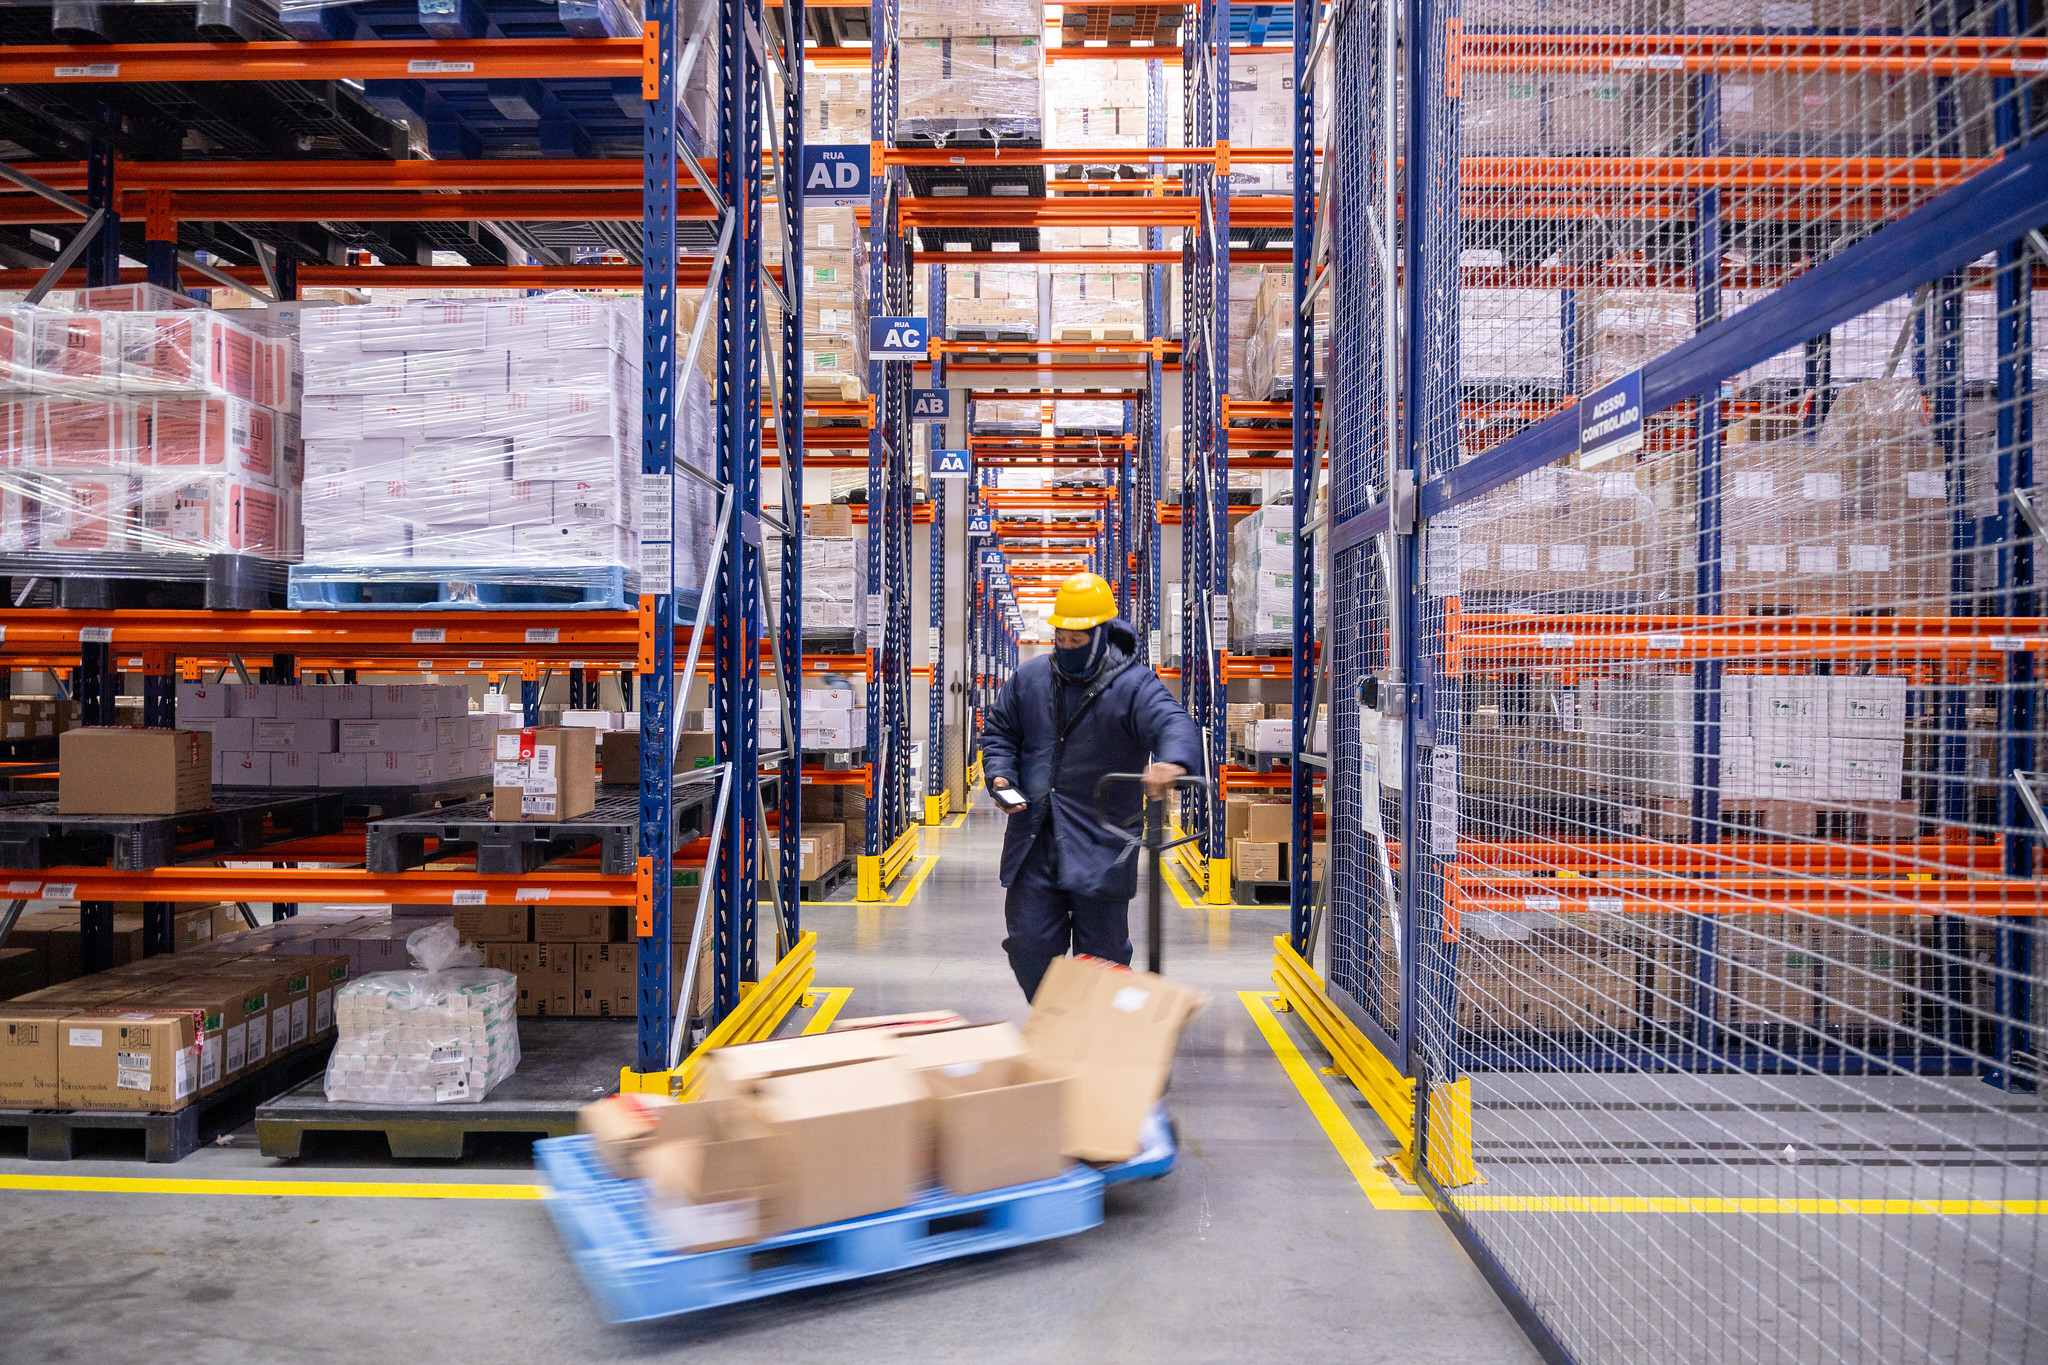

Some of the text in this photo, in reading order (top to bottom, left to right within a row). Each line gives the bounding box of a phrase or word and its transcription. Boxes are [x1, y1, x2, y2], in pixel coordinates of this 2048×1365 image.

[822, 152, 845, 160] RUA
[806, 162, 861, 189] AD
[883, 328, 921, 348] AC
[913, 398, 945, 414] AB
[1592, 392, 1626, 420] ACESSO
[1582, 406, 1639, 444] CONTROLADO
[940, 458, 964, 470] AA
[969, 521, 988, 530] AG
[978, 537, 994, 546] AF
[986, 555, 1001, 563] AE
[87, 1083, 107, 1092] nordisk
[107, 1101, 129, 1109] nordisk
